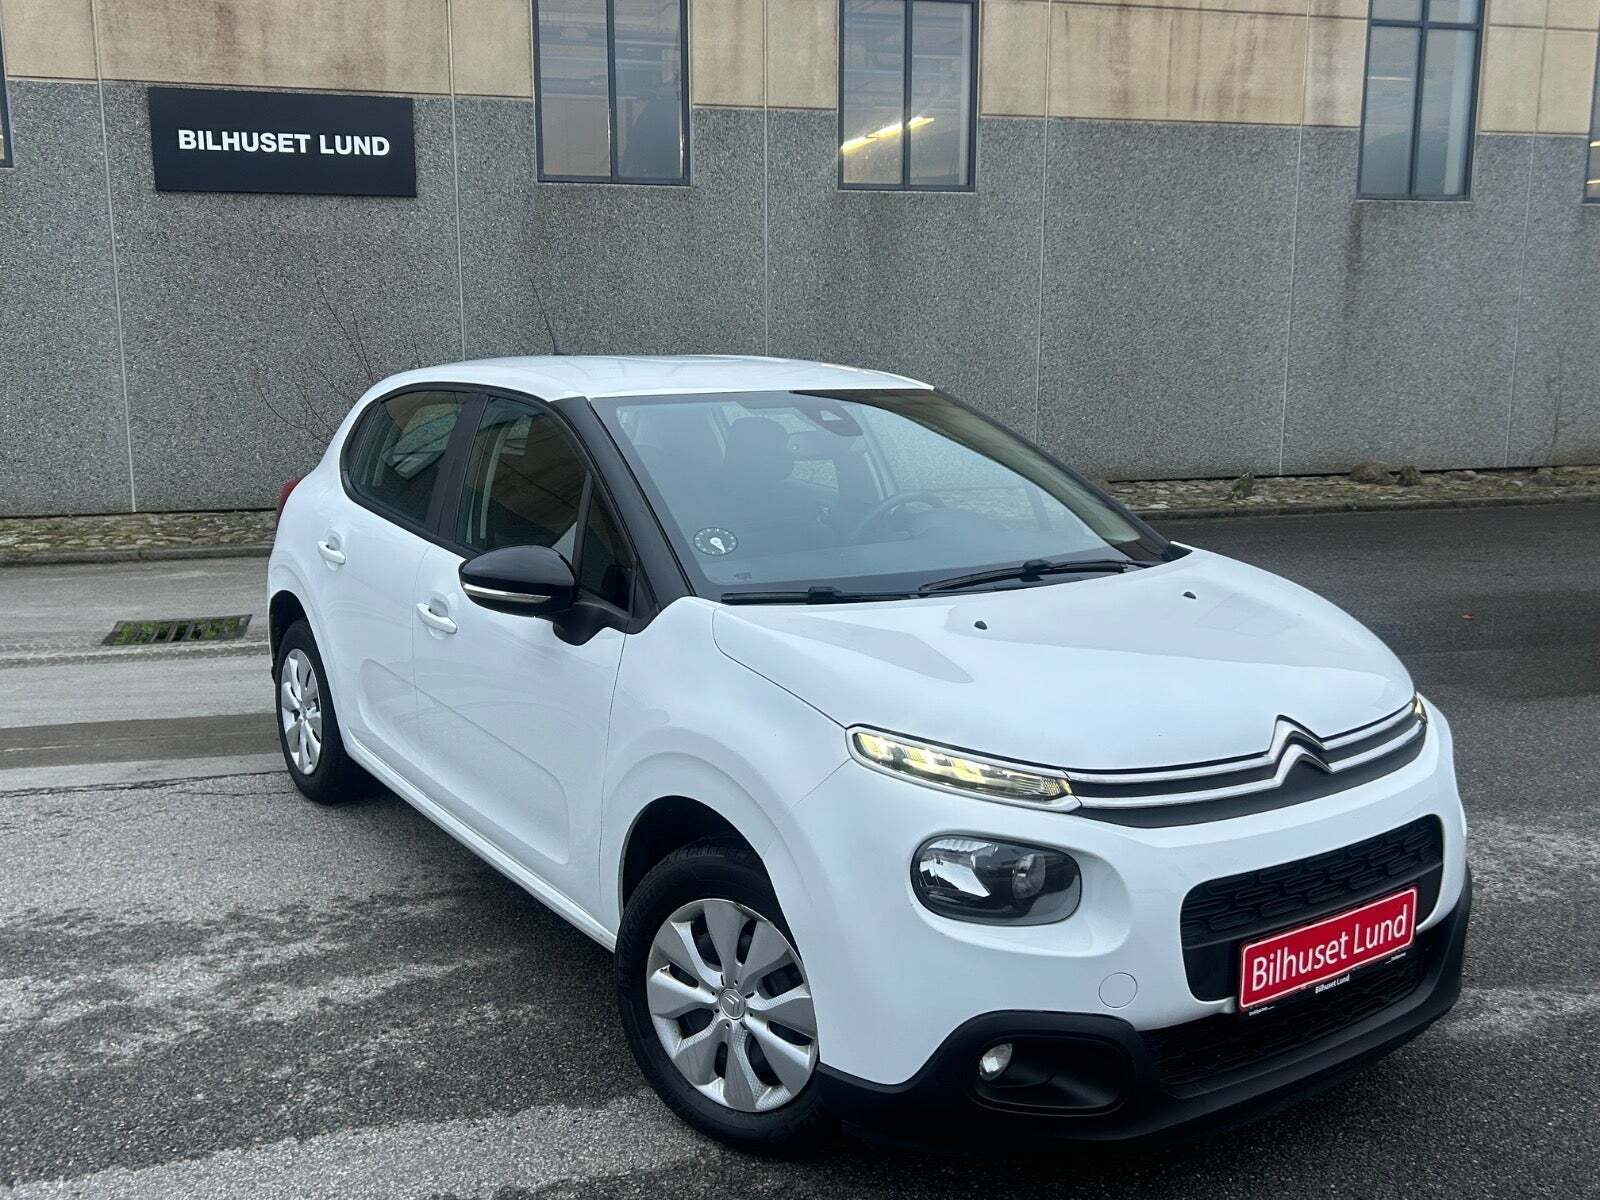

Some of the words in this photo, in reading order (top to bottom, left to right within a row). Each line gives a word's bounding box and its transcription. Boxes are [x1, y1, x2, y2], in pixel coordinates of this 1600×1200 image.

[178, 129, 310, 154] BILHUSET
[319, 134, 390, 156] LUND
[1251, 931, 1349, 992] Bilhuset
[1353, 903, 1408, 956] Lund
[1336, 973, 1350, 986] Lund
